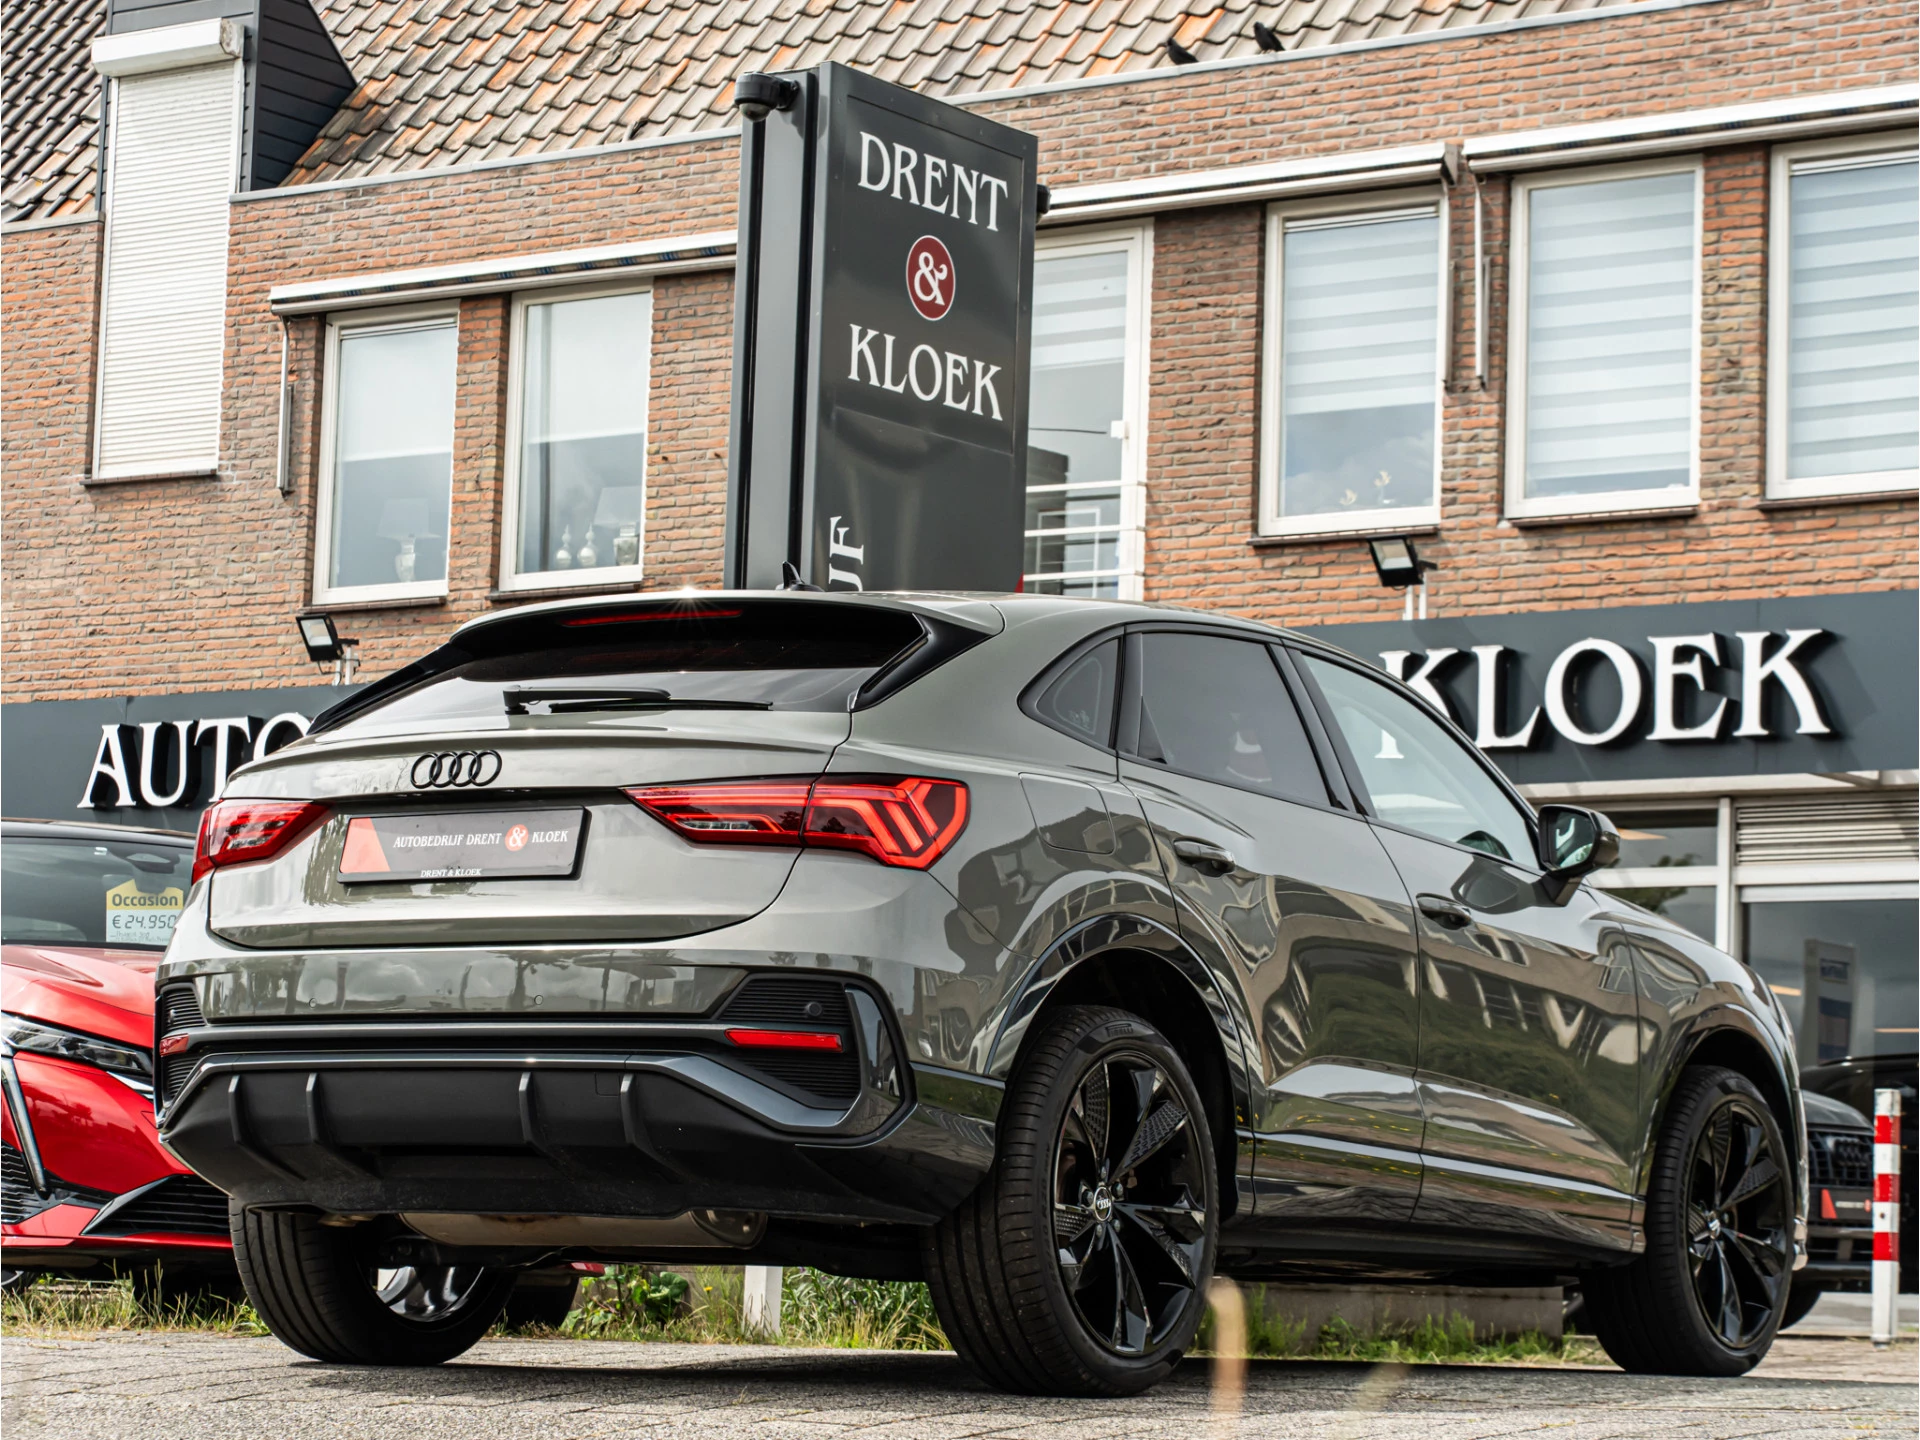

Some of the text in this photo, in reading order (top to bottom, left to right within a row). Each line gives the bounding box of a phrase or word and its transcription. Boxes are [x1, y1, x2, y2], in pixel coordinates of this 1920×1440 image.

[858, 131, 1008, 232] DRENT
[913, 251, 948, 307] &
[847, 323, 1004, 421] KLOEK
[1374, 628, 1832, 759] KLOEK
[393, 827, 569, 848] AUTOBEDRIJF DRENT & KLOEK
[112, 893, 178, 907] Occasion
[420, 869, 447, 878] DRENT
[454, 868, 482, 877] KLOEK
